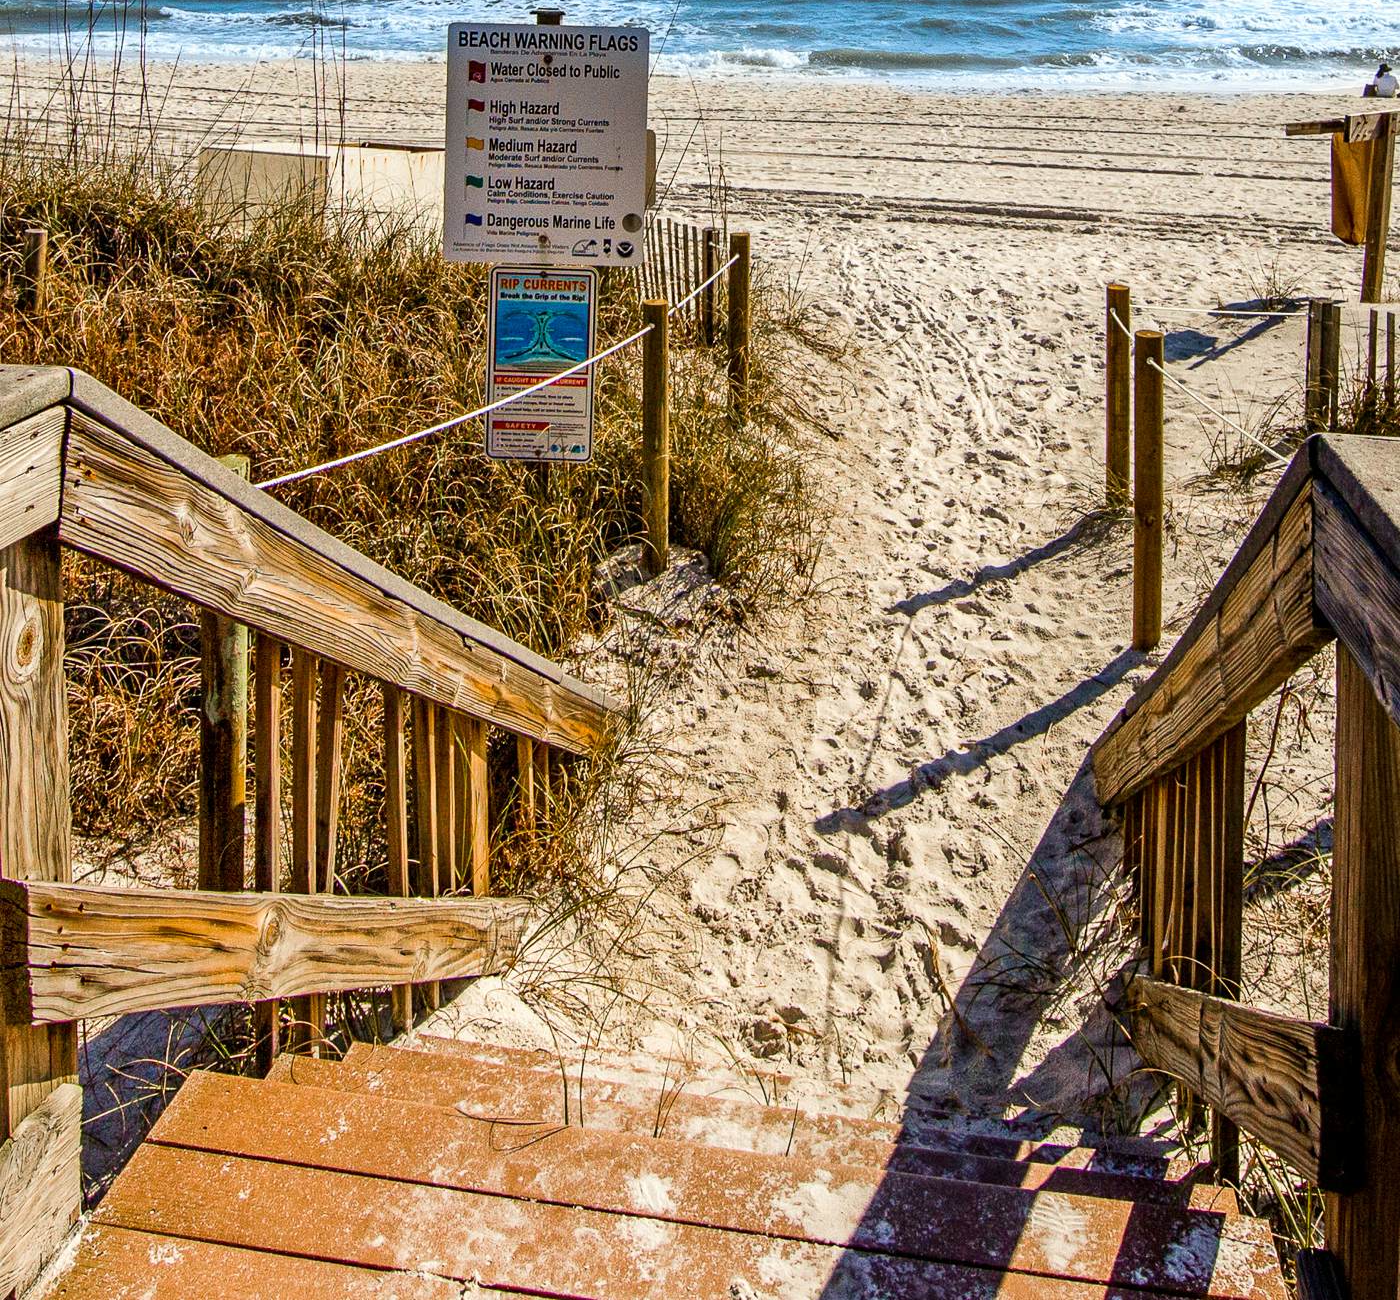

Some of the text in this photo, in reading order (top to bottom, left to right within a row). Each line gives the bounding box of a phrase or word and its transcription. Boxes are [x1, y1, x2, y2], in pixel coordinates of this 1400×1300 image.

[458, 31, 638, 52] BEACH WARNING FLAGS
[490, 62, 620, 79] Water Closed to Public
[489, 100, 560, 117] High Hazard
[489, 116, 610, 127] High Surf and/or Strong Currents
[488, 138, 577, 153] Medium Hazard
[488, 153, 599, 164] Moderate Surf and/or Currents
[488, 176, 555, 190] Low Hazard
[487, 189, 615, 201] Calm Conditions, Exercise Caution
[487, 213, 616, 230] Dangerous Marine Life
[500, 278, 587, 292] RIP CURRENTS
[534, 293, 549, 301] Grip
[571, 294, 586, 302] Rip!
